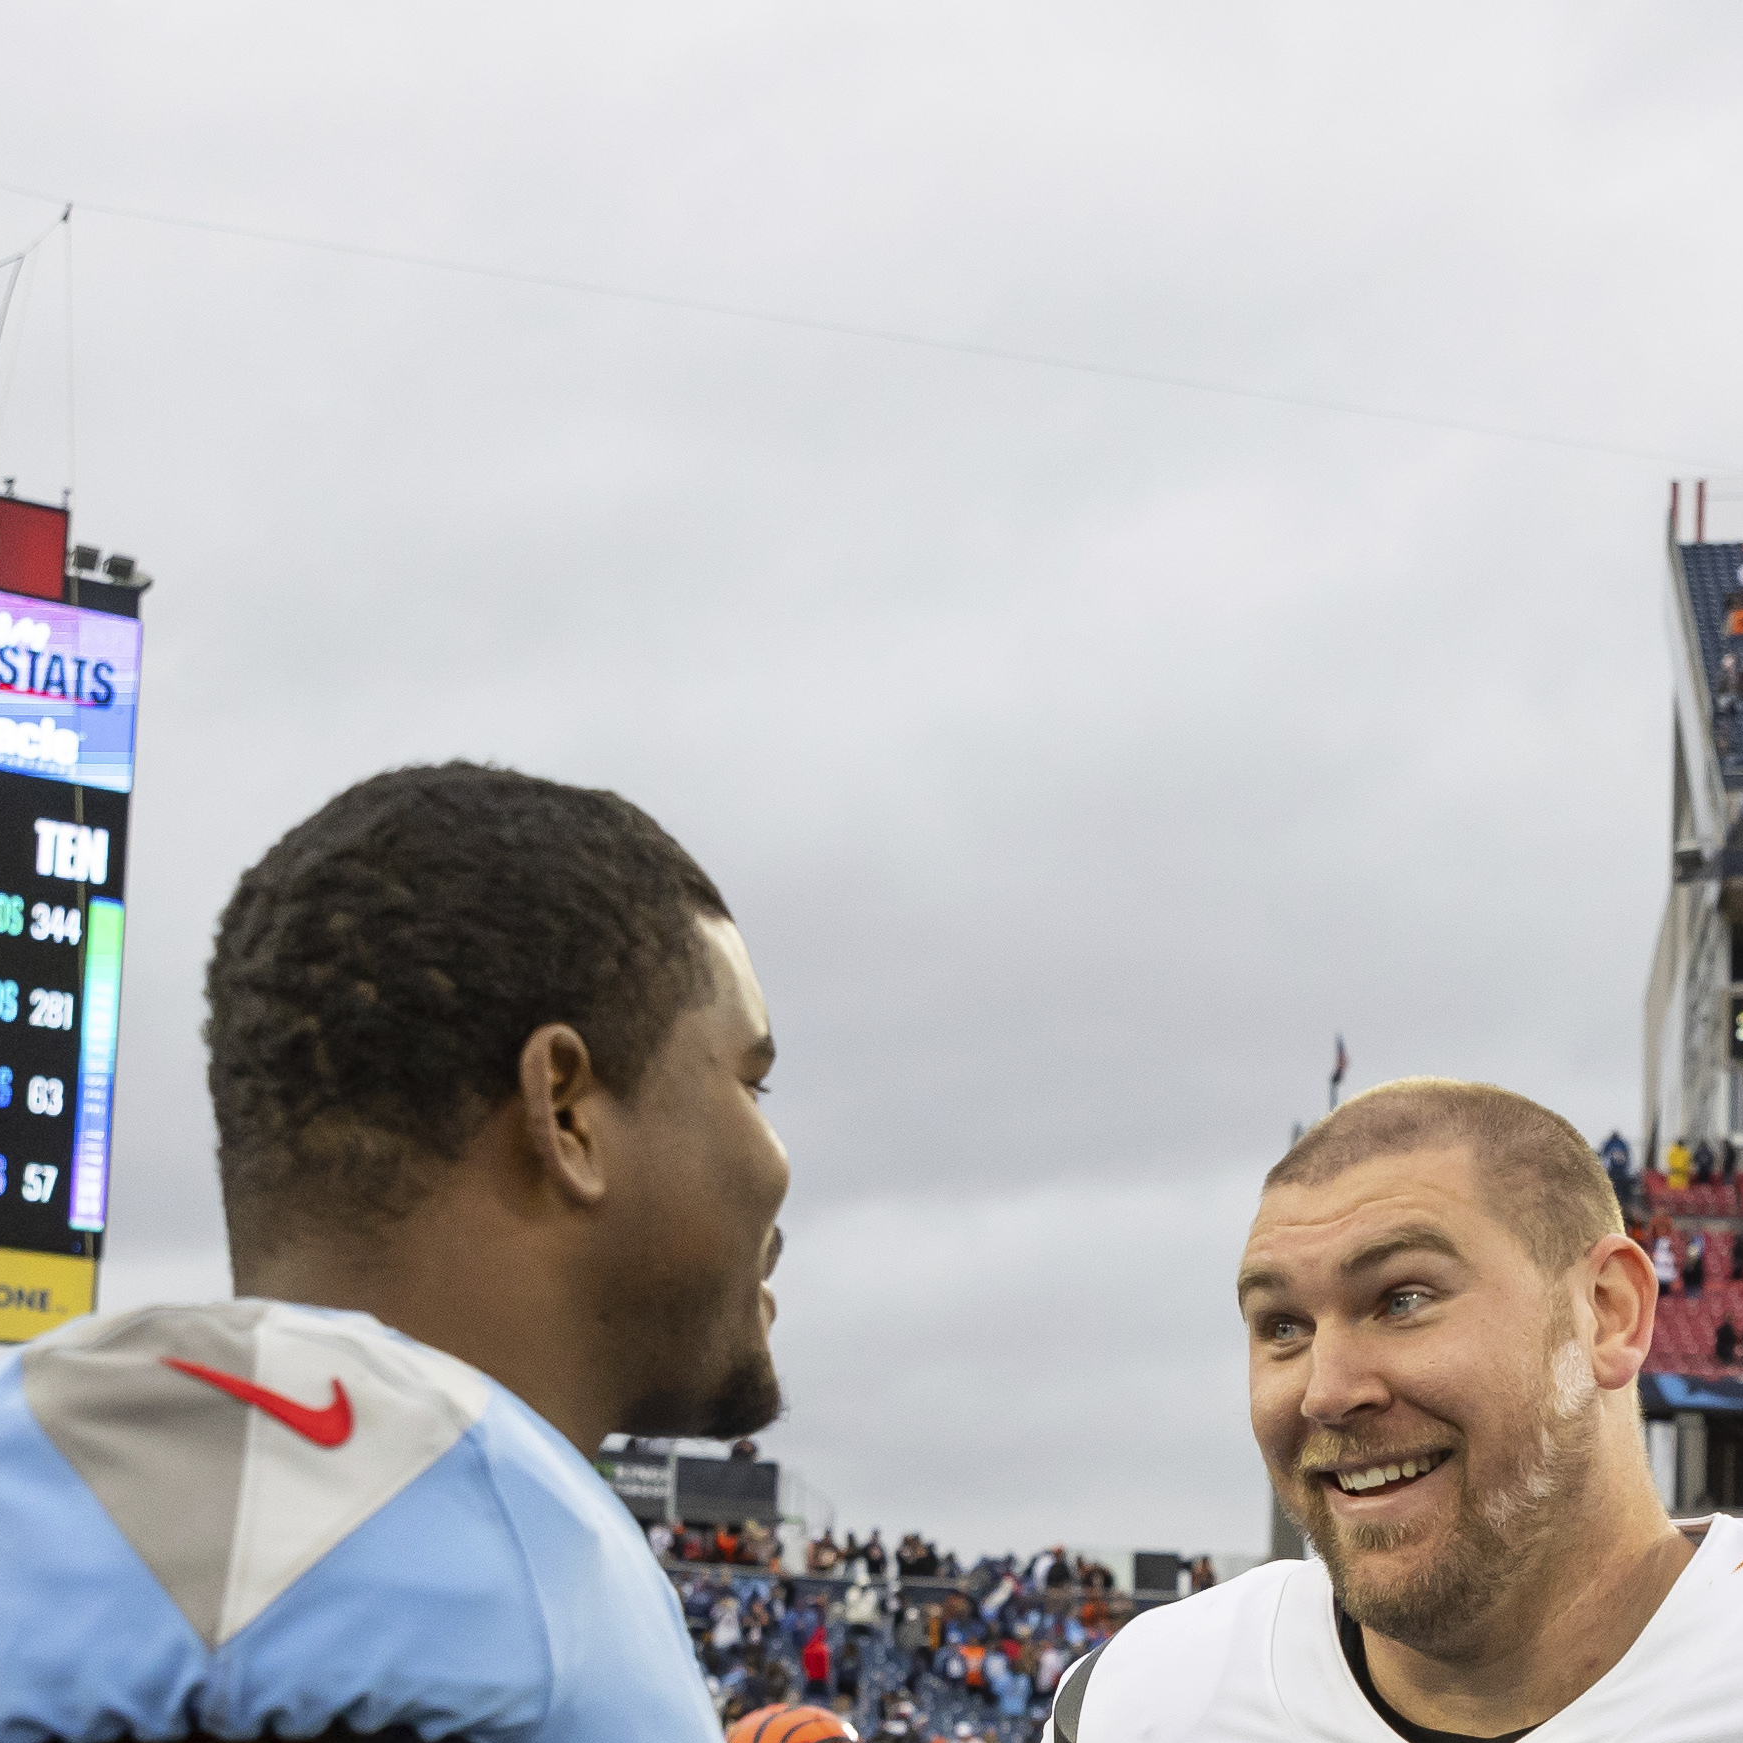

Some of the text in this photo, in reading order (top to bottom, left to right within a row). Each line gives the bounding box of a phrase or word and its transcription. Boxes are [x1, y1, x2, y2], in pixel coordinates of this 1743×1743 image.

[34, 817, 109, 884] TEN
[31, 902, 82, 946] 344
[29, 988, 75, 1031] 281
[27, 1075, 64, 1117] 63
[21, 1162, 58, 1203] 57
